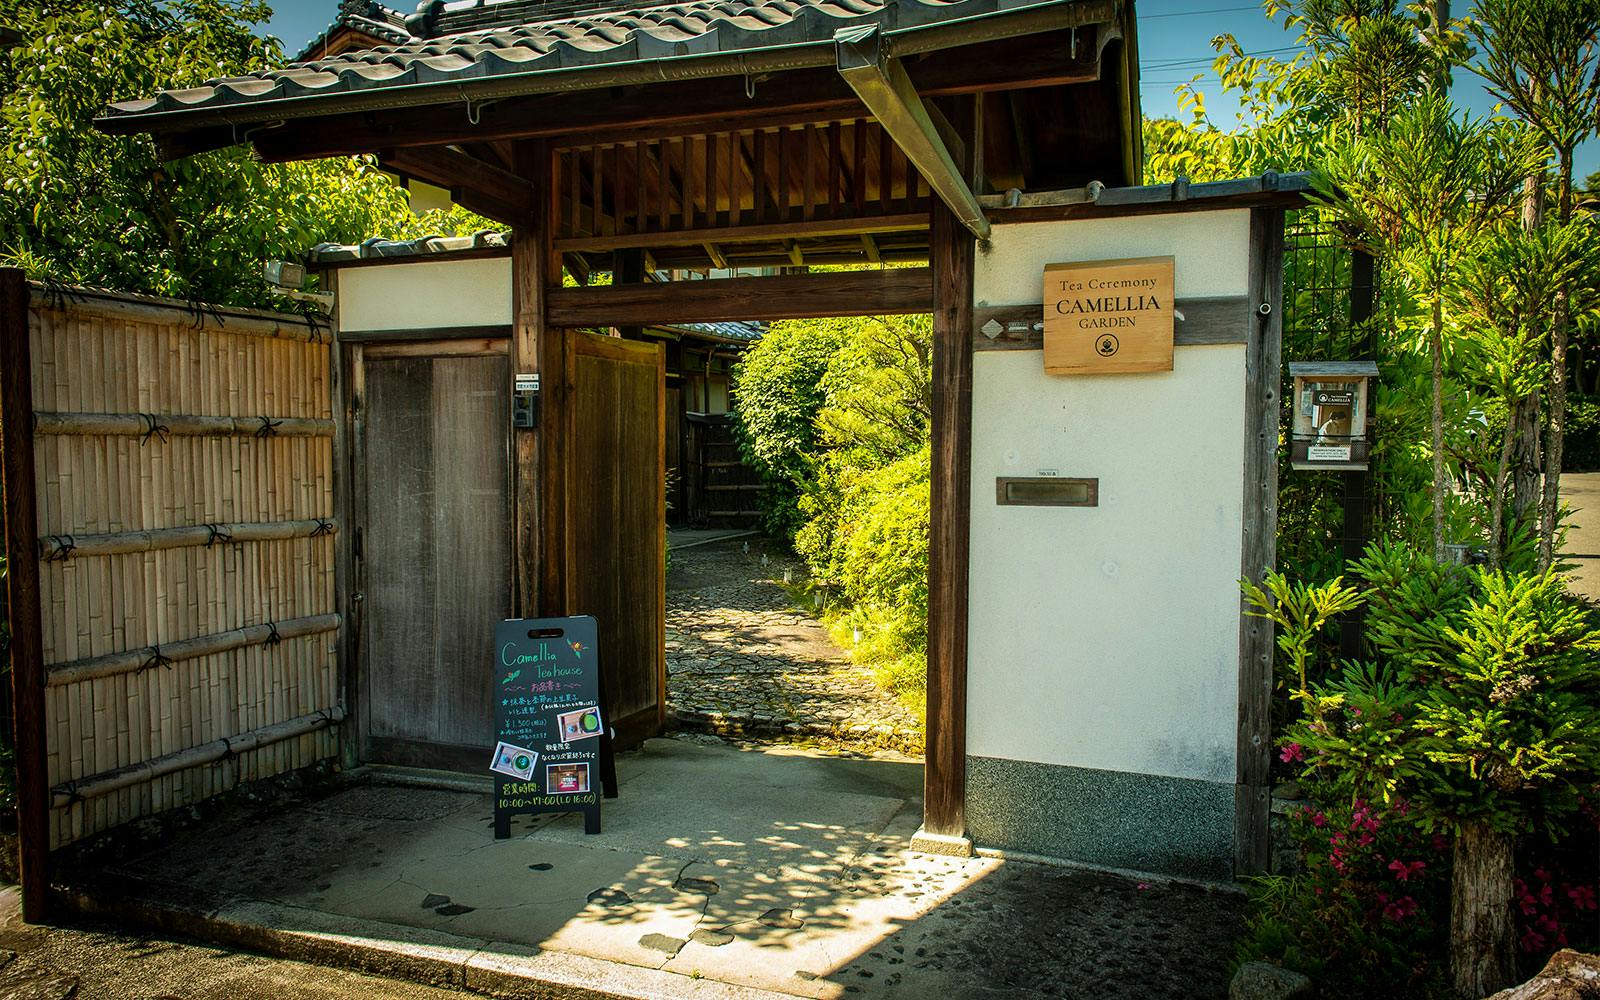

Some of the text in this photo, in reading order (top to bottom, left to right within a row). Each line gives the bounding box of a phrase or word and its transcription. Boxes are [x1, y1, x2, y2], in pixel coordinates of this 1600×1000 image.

[1060, 279, 1157, 291] Tea Ceremony
[1056, 295, 1160, 315] CAMELLIA
[1079, 316, 1136, 329] GARDEN
[502, 642, 557, 666] Camellia
